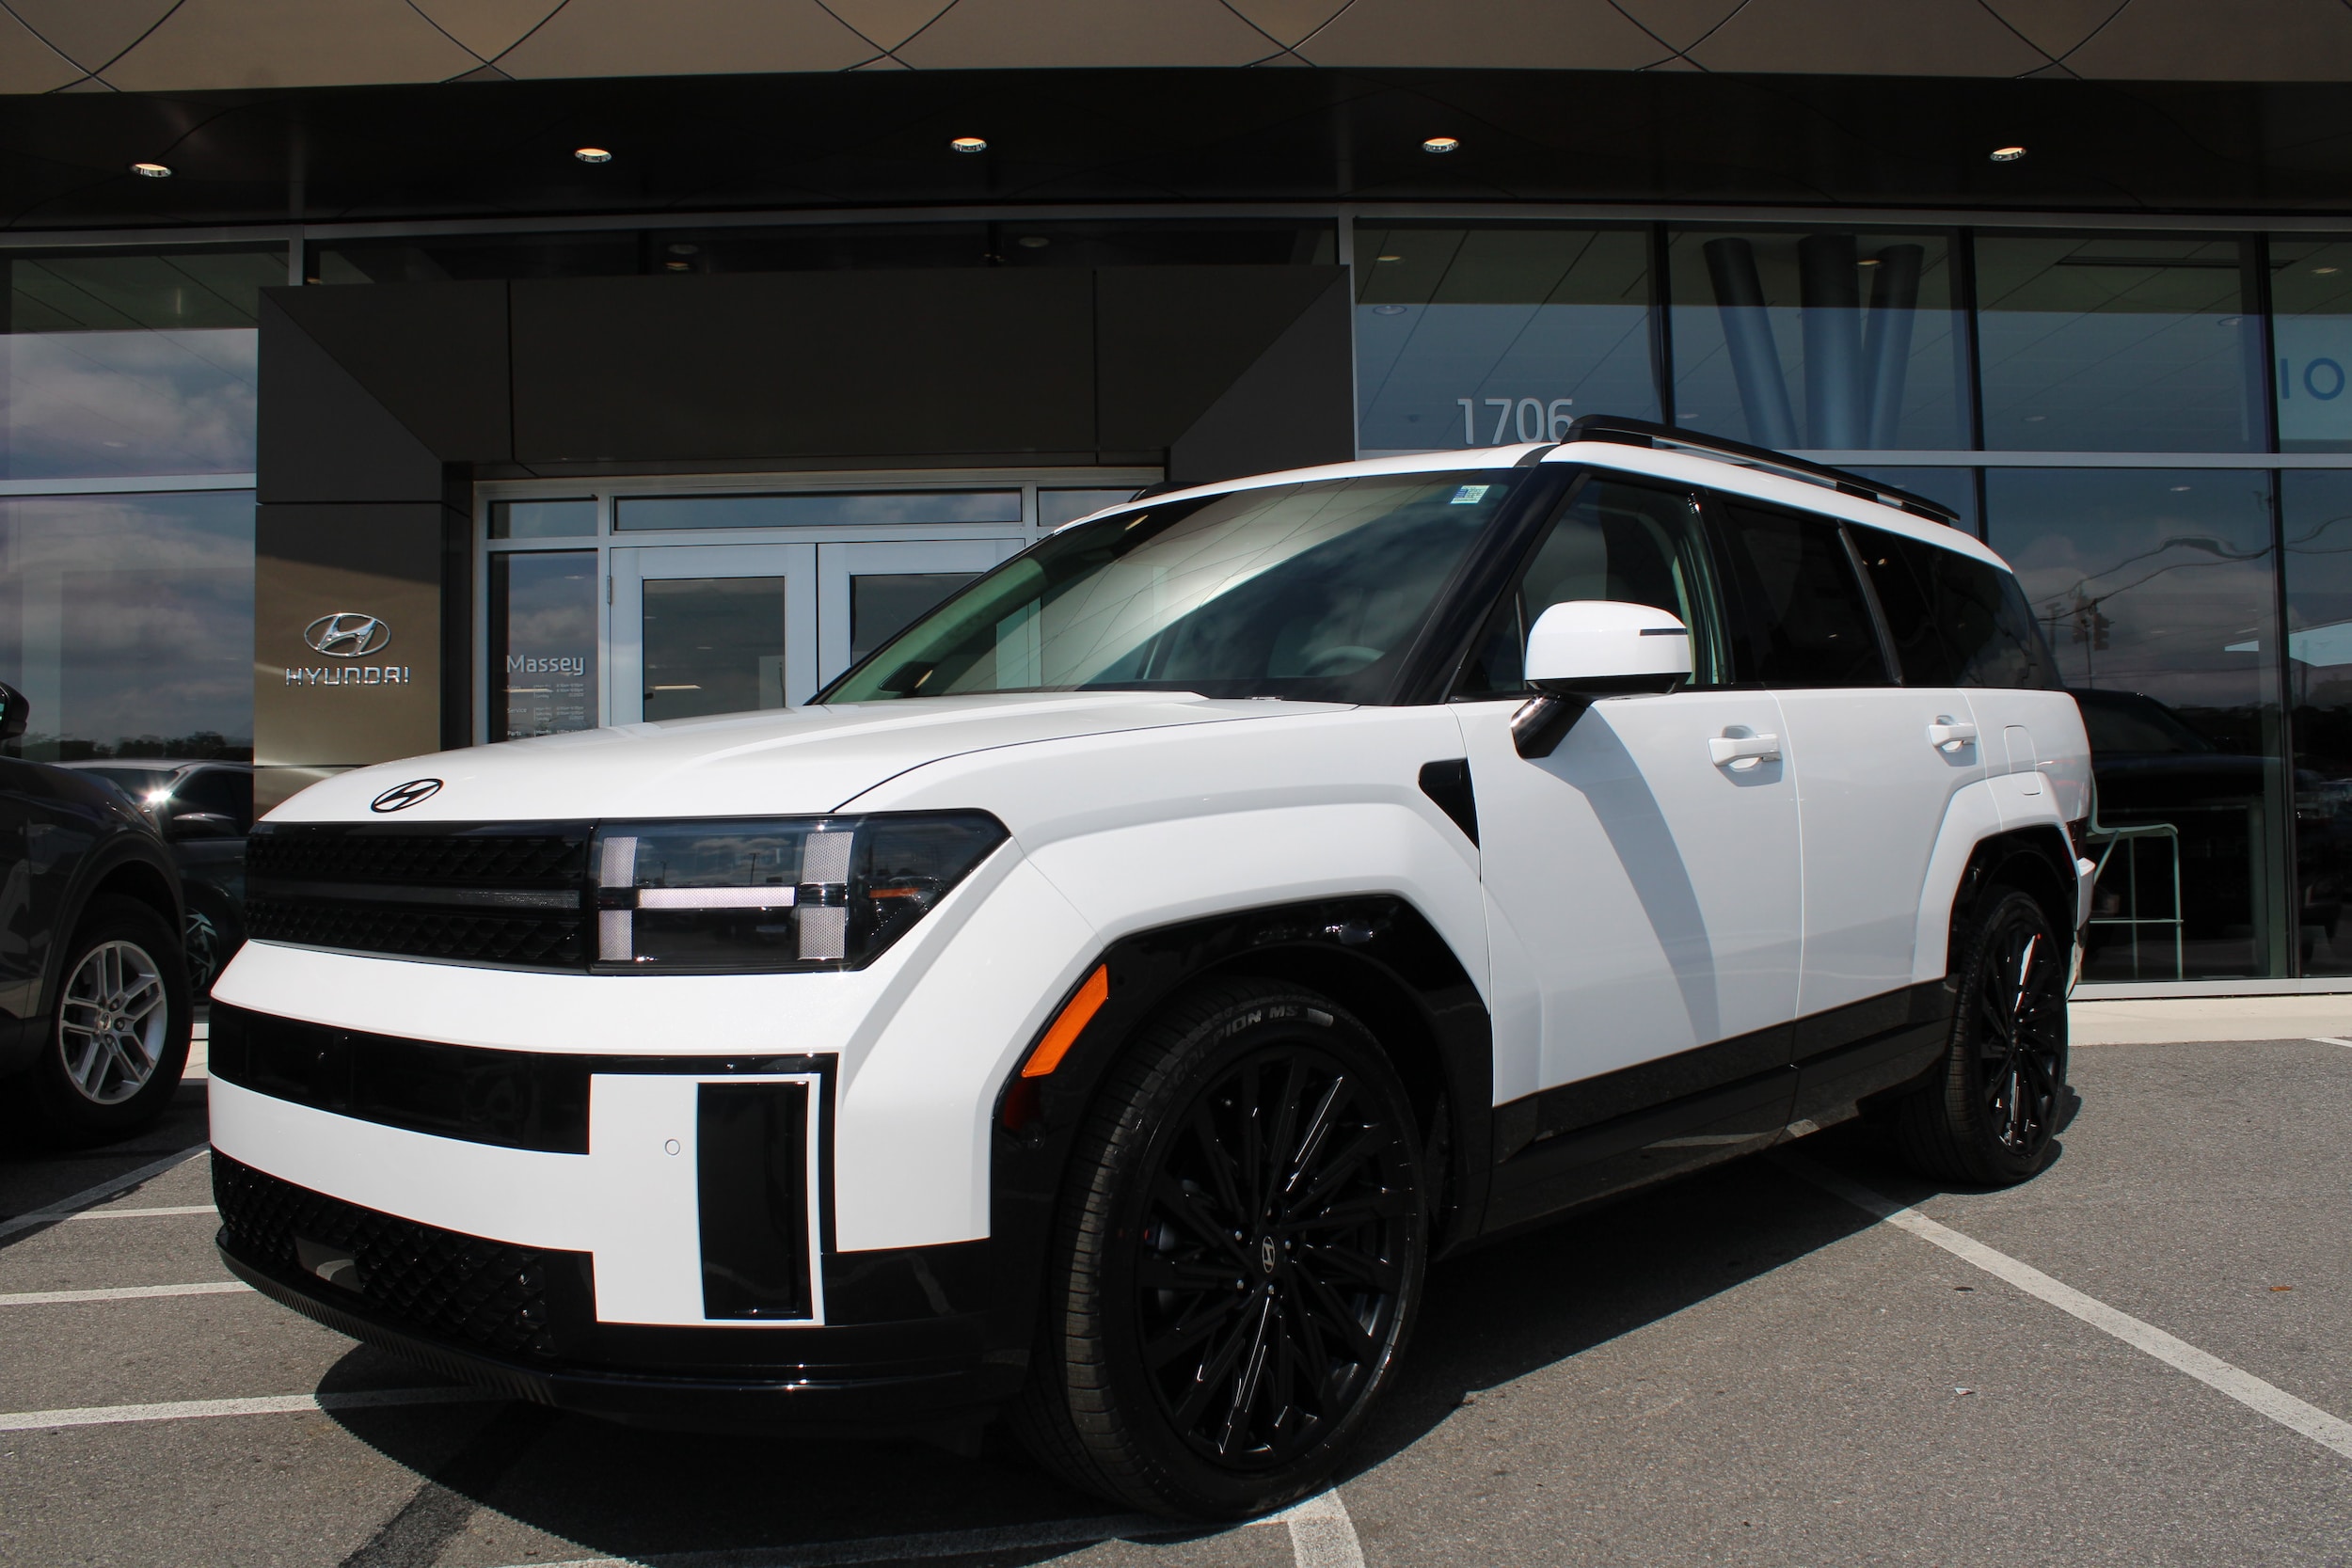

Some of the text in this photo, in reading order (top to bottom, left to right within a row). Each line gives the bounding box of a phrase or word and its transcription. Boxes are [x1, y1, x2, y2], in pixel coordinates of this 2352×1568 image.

[1456, 398, 1574, 445] 1706
[285, 666, 410, 685] HYUNDAI
[506, 655, 584, 676] Massey
